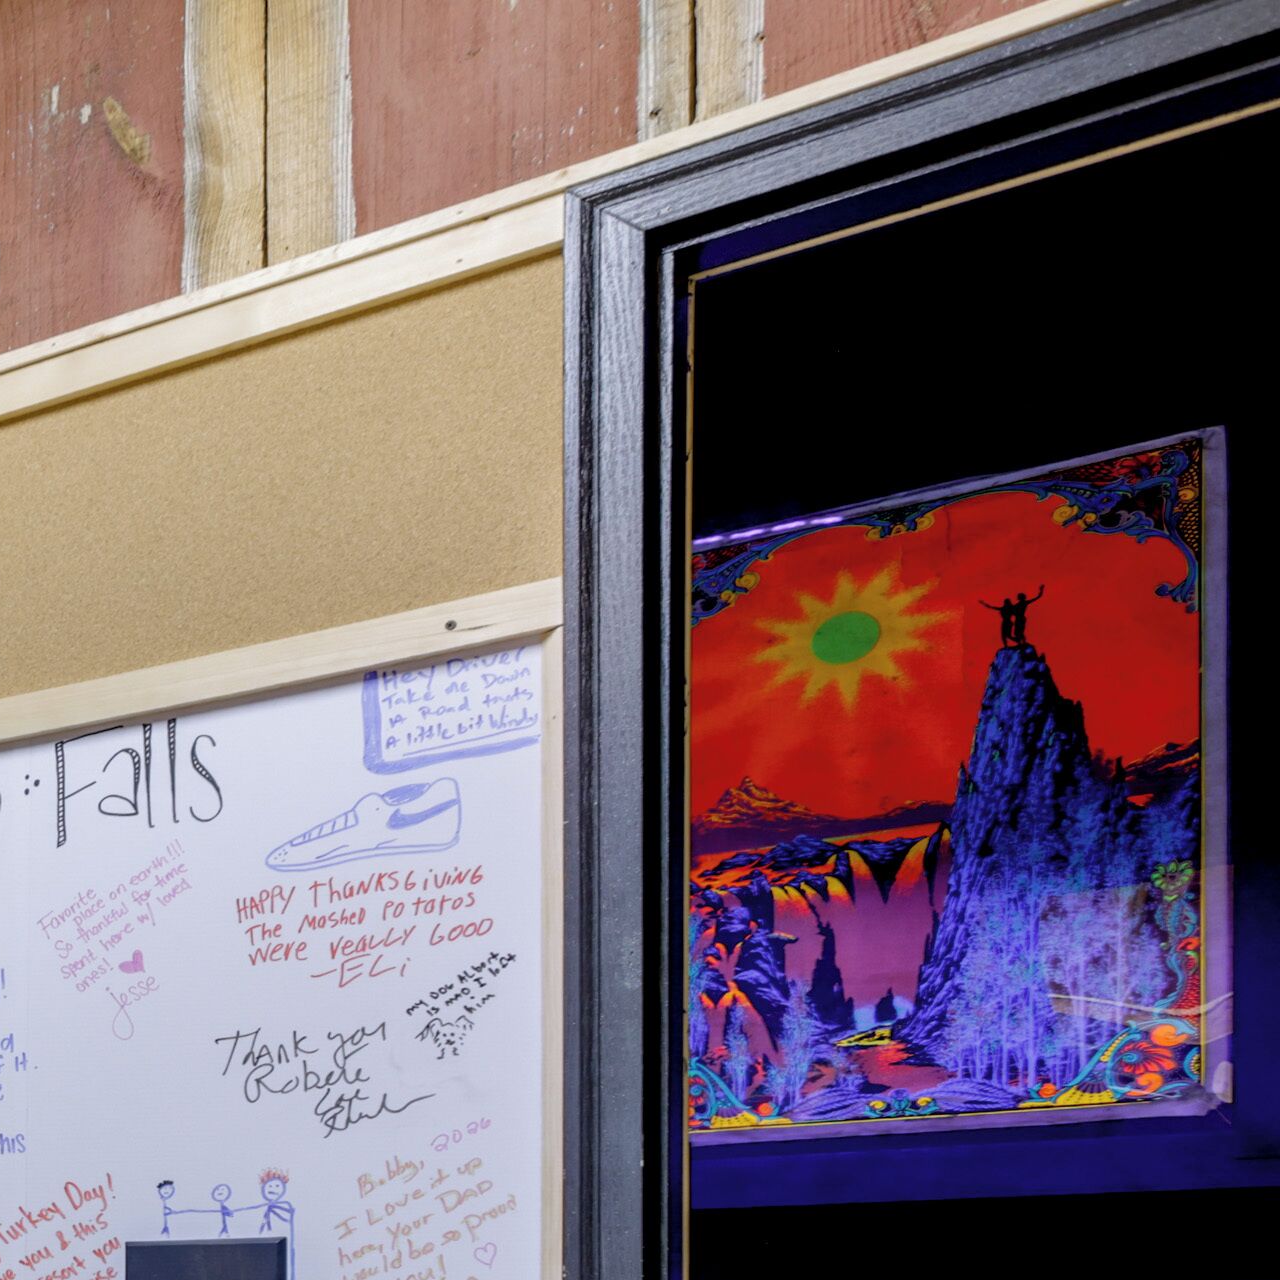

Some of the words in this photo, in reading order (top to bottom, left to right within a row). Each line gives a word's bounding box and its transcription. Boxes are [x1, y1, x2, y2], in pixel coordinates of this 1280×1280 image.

[54, 717, 224, 848] Falls
[109, 883, 127, 901] on
[63, 1171, 118, 1212] Day!
[72, 1212, 109, 1242] this
[334, 1215, 358, 1240] I
[406, 1238, 436, 1261] be
